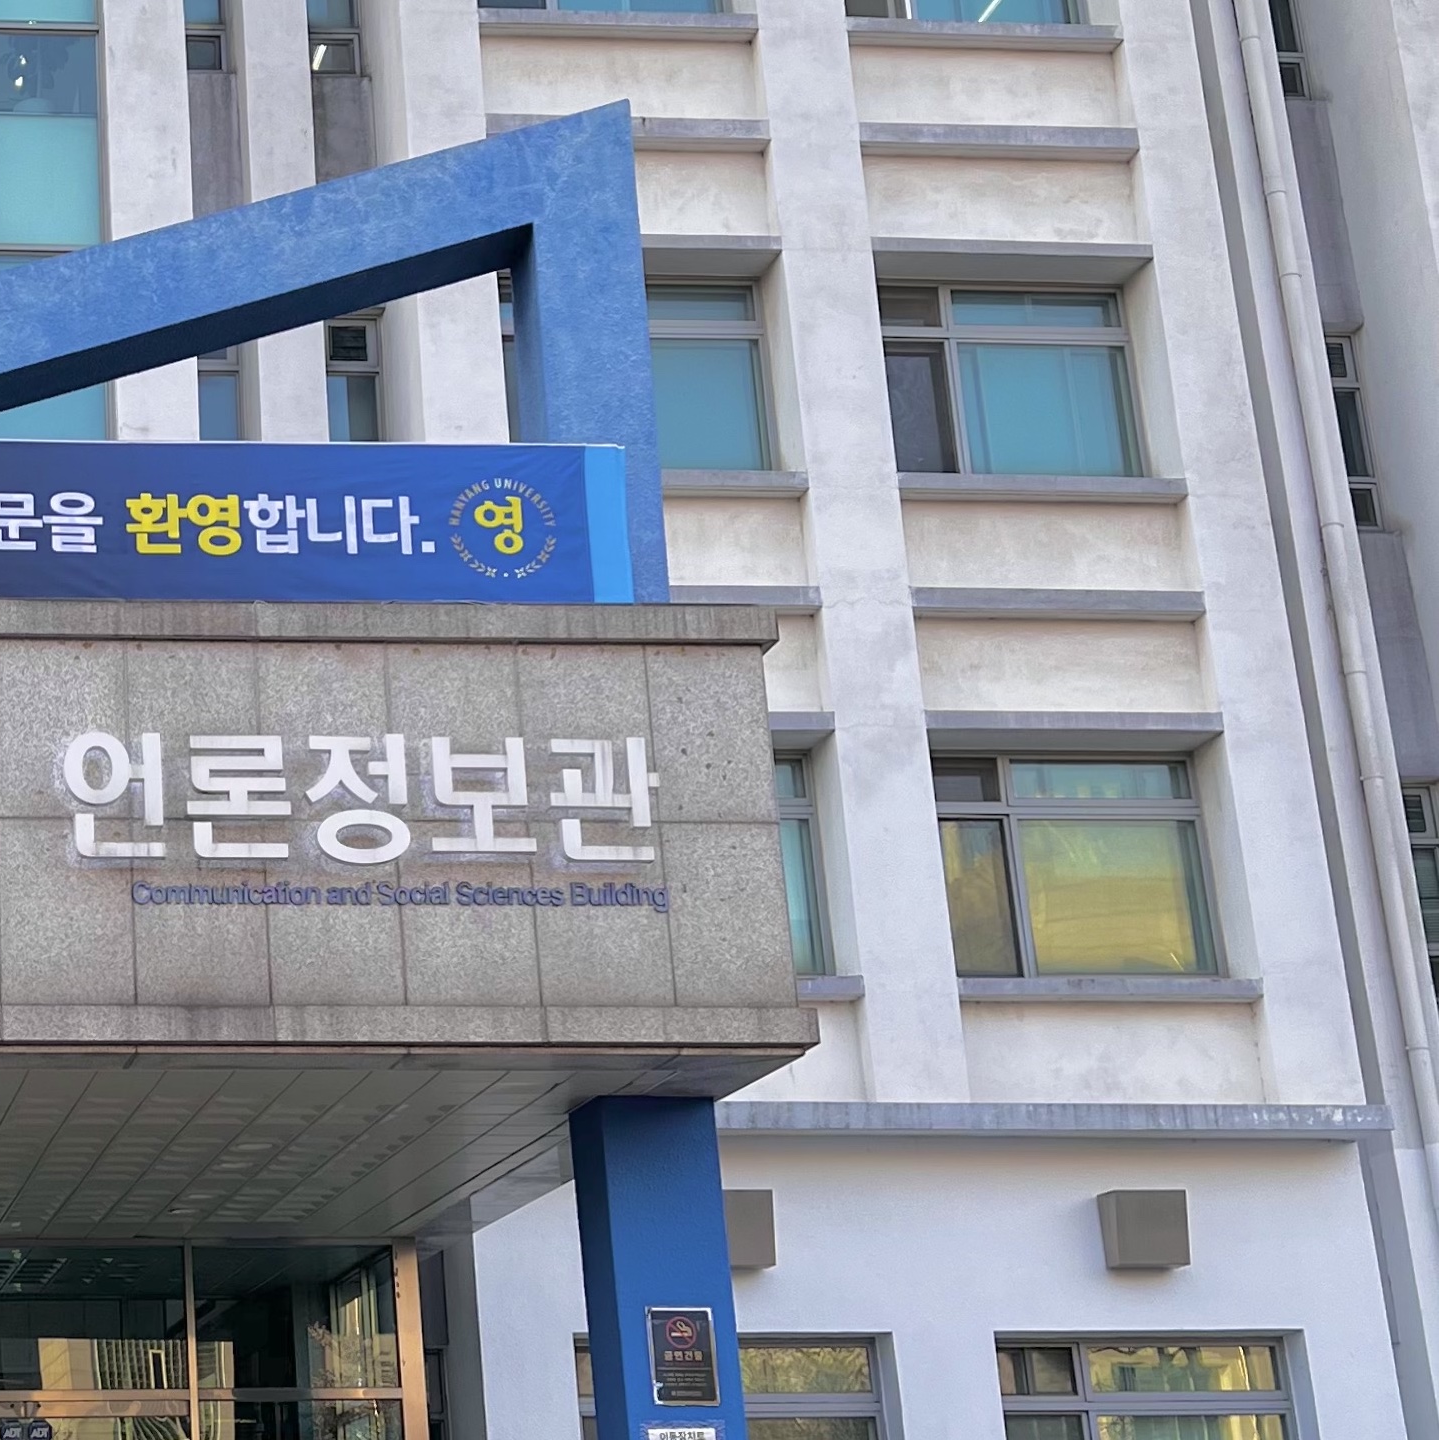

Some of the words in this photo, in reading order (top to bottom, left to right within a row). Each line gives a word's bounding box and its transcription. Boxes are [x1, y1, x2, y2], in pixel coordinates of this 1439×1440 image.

[125, 492, 437, 556] 환영합니다.
[448, 480, 490, 526] HANYANG
[494, 478, 557, 527] UNIVERSITY
[473, 495, 524, 555] 영
[62, 732, 660, 864] 언론정보관
[131, 881, 323, 908] Communication
[327, 880, 371, 907] and
[376, 881, 450, 907] Social
[456, 881, 562, 908] Sciences
[569, 881, 669, 914] Building
[3, 1427, 22, 1438] ADT
[30, 1427, 49, 1438] ADT
